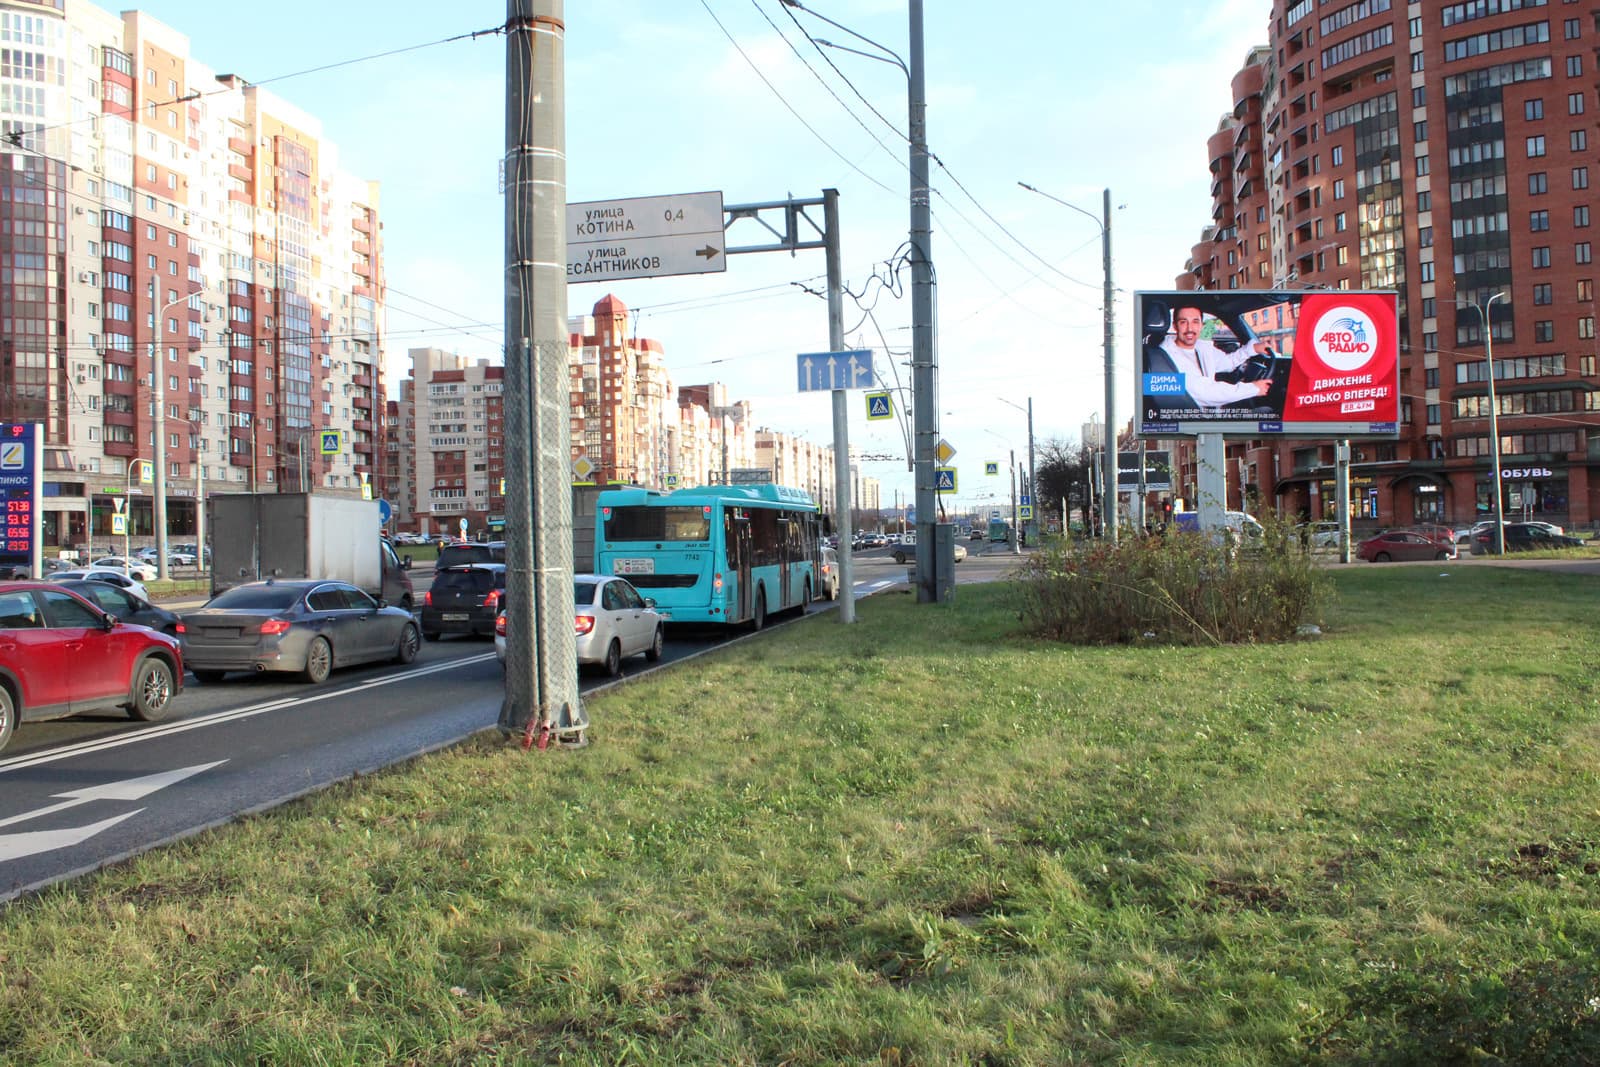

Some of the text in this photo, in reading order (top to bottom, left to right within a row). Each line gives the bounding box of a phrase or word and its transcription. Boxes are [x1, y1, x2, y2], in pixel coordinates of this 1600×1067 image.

[585, 207, 625, 222] улица
[576, 219, 635, 236] КОТИНА
[587, 246, 627, 262] улица
[566, 256, 661, 276] ЕСАНТНИКОВ
[1319, 332, 1352, 343] АВТО
[1328, 342, 1370, 353] РАДИО
[1150, 375, 1177, 385] ДИМА
[1313, 374, 1373, 391] ДВИЖЕНИЕ
[1150, 384, 1182, 392] БИЛАН
[1298, 387, 1388, 405] ТОЛЬКО ВПЕРЕД!
[1501, 467, 1553, 479] ОБУВЬ
